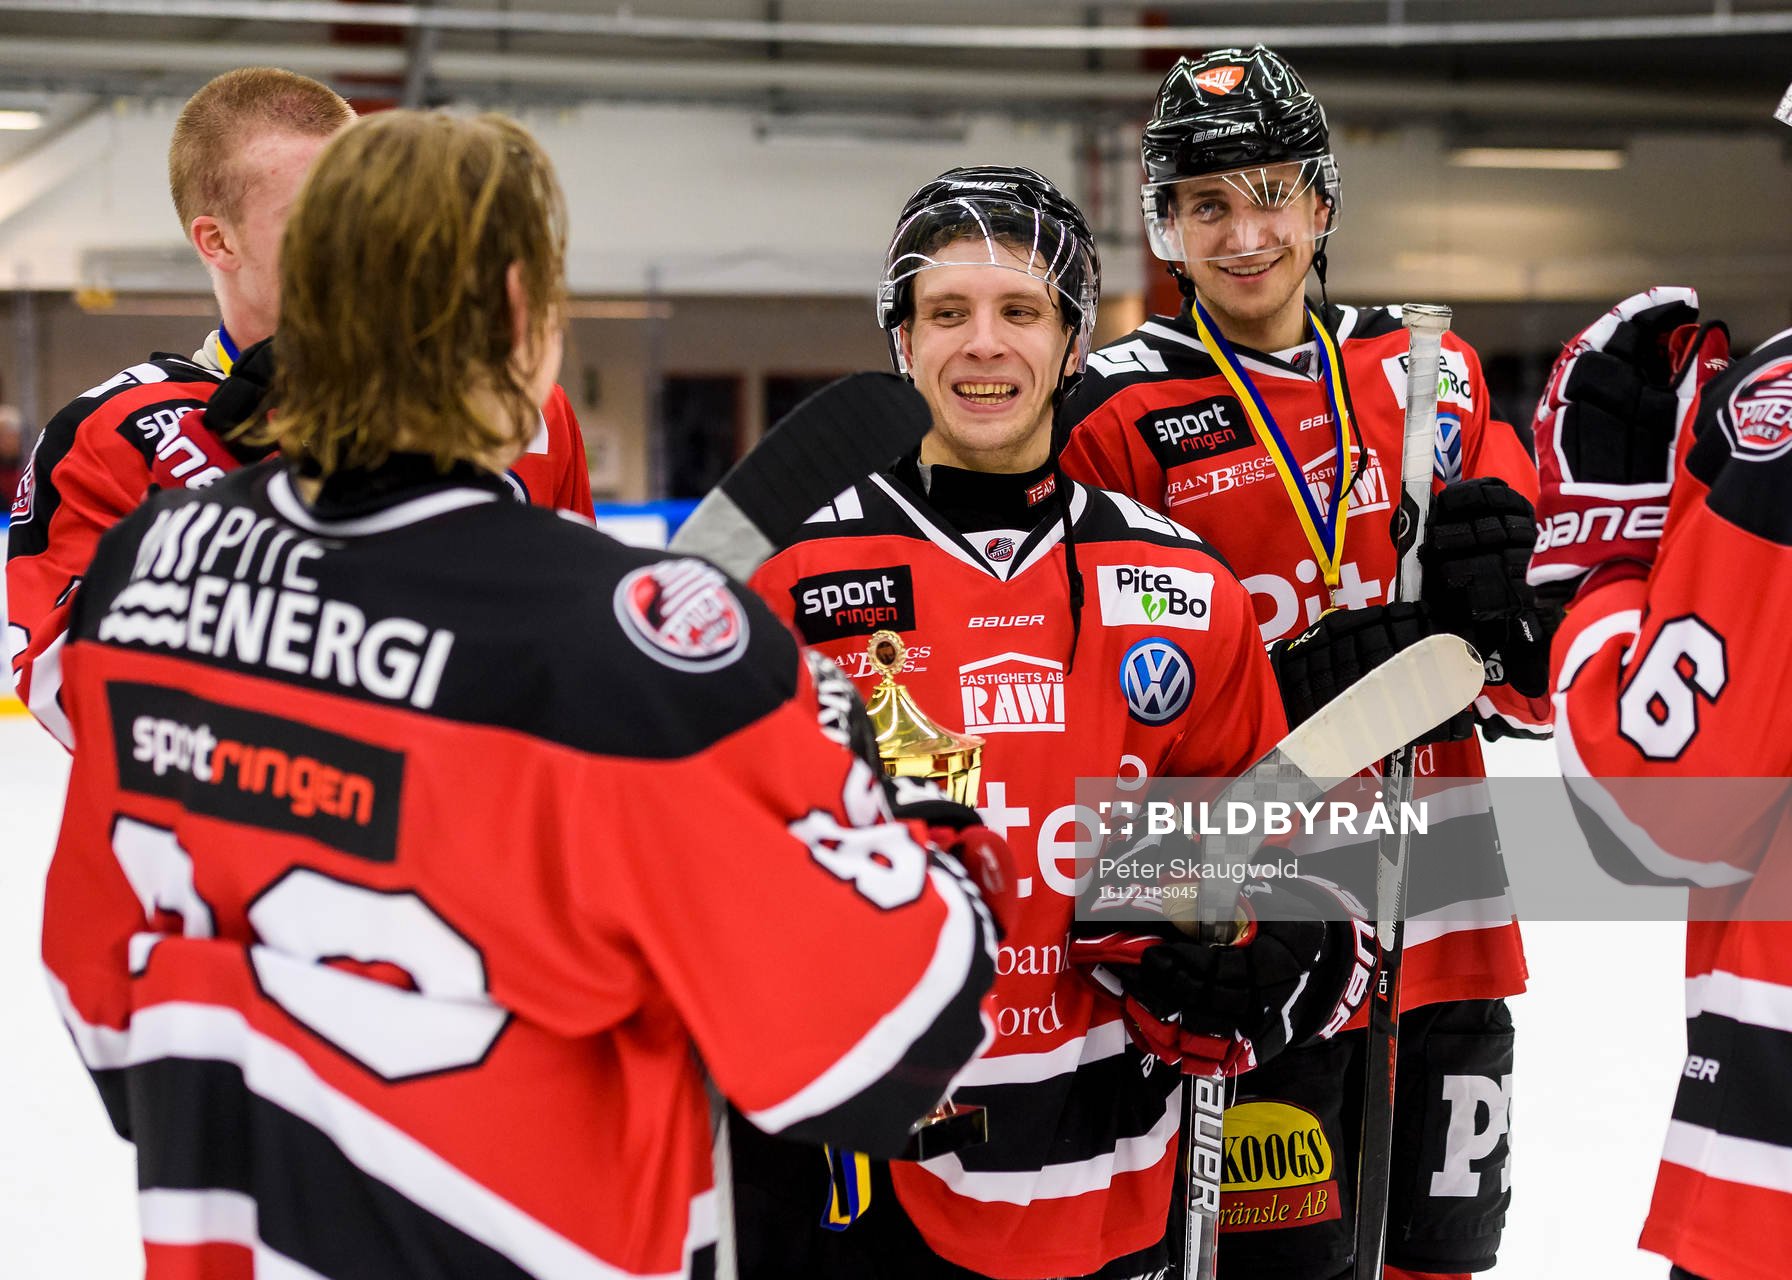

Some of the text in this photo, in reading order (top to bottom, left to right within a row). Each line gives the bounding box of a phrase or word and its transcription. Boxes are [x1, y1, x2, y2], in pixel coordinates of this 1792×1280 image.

[1154, 403, 1231, 445] sport
[1299, 410, 1349, 431] BAU
[1181, 428, 1237, 452] ringen
[1029, 480, 1056, 503] TEAM
[802, 575, 897, 618] sport
[1115, 567, 1173, 594] Pite
[835, 606, 898, 628] ringen
[1167, 587, 1207, 619] Bo
[967, 614, 1045, 629] BAUER
[187, 575, 455, 710] ENERGI
[959, 671, 1064, 686] FASTIGHETS AB
[991, 992, 1064, 1036] ord
[1190, 1077, 1224, 1213] AUER
[1220, 1127, 1325, 1184] KOOGS
[1219, 1189, 1329, 1226] ränsle AB
